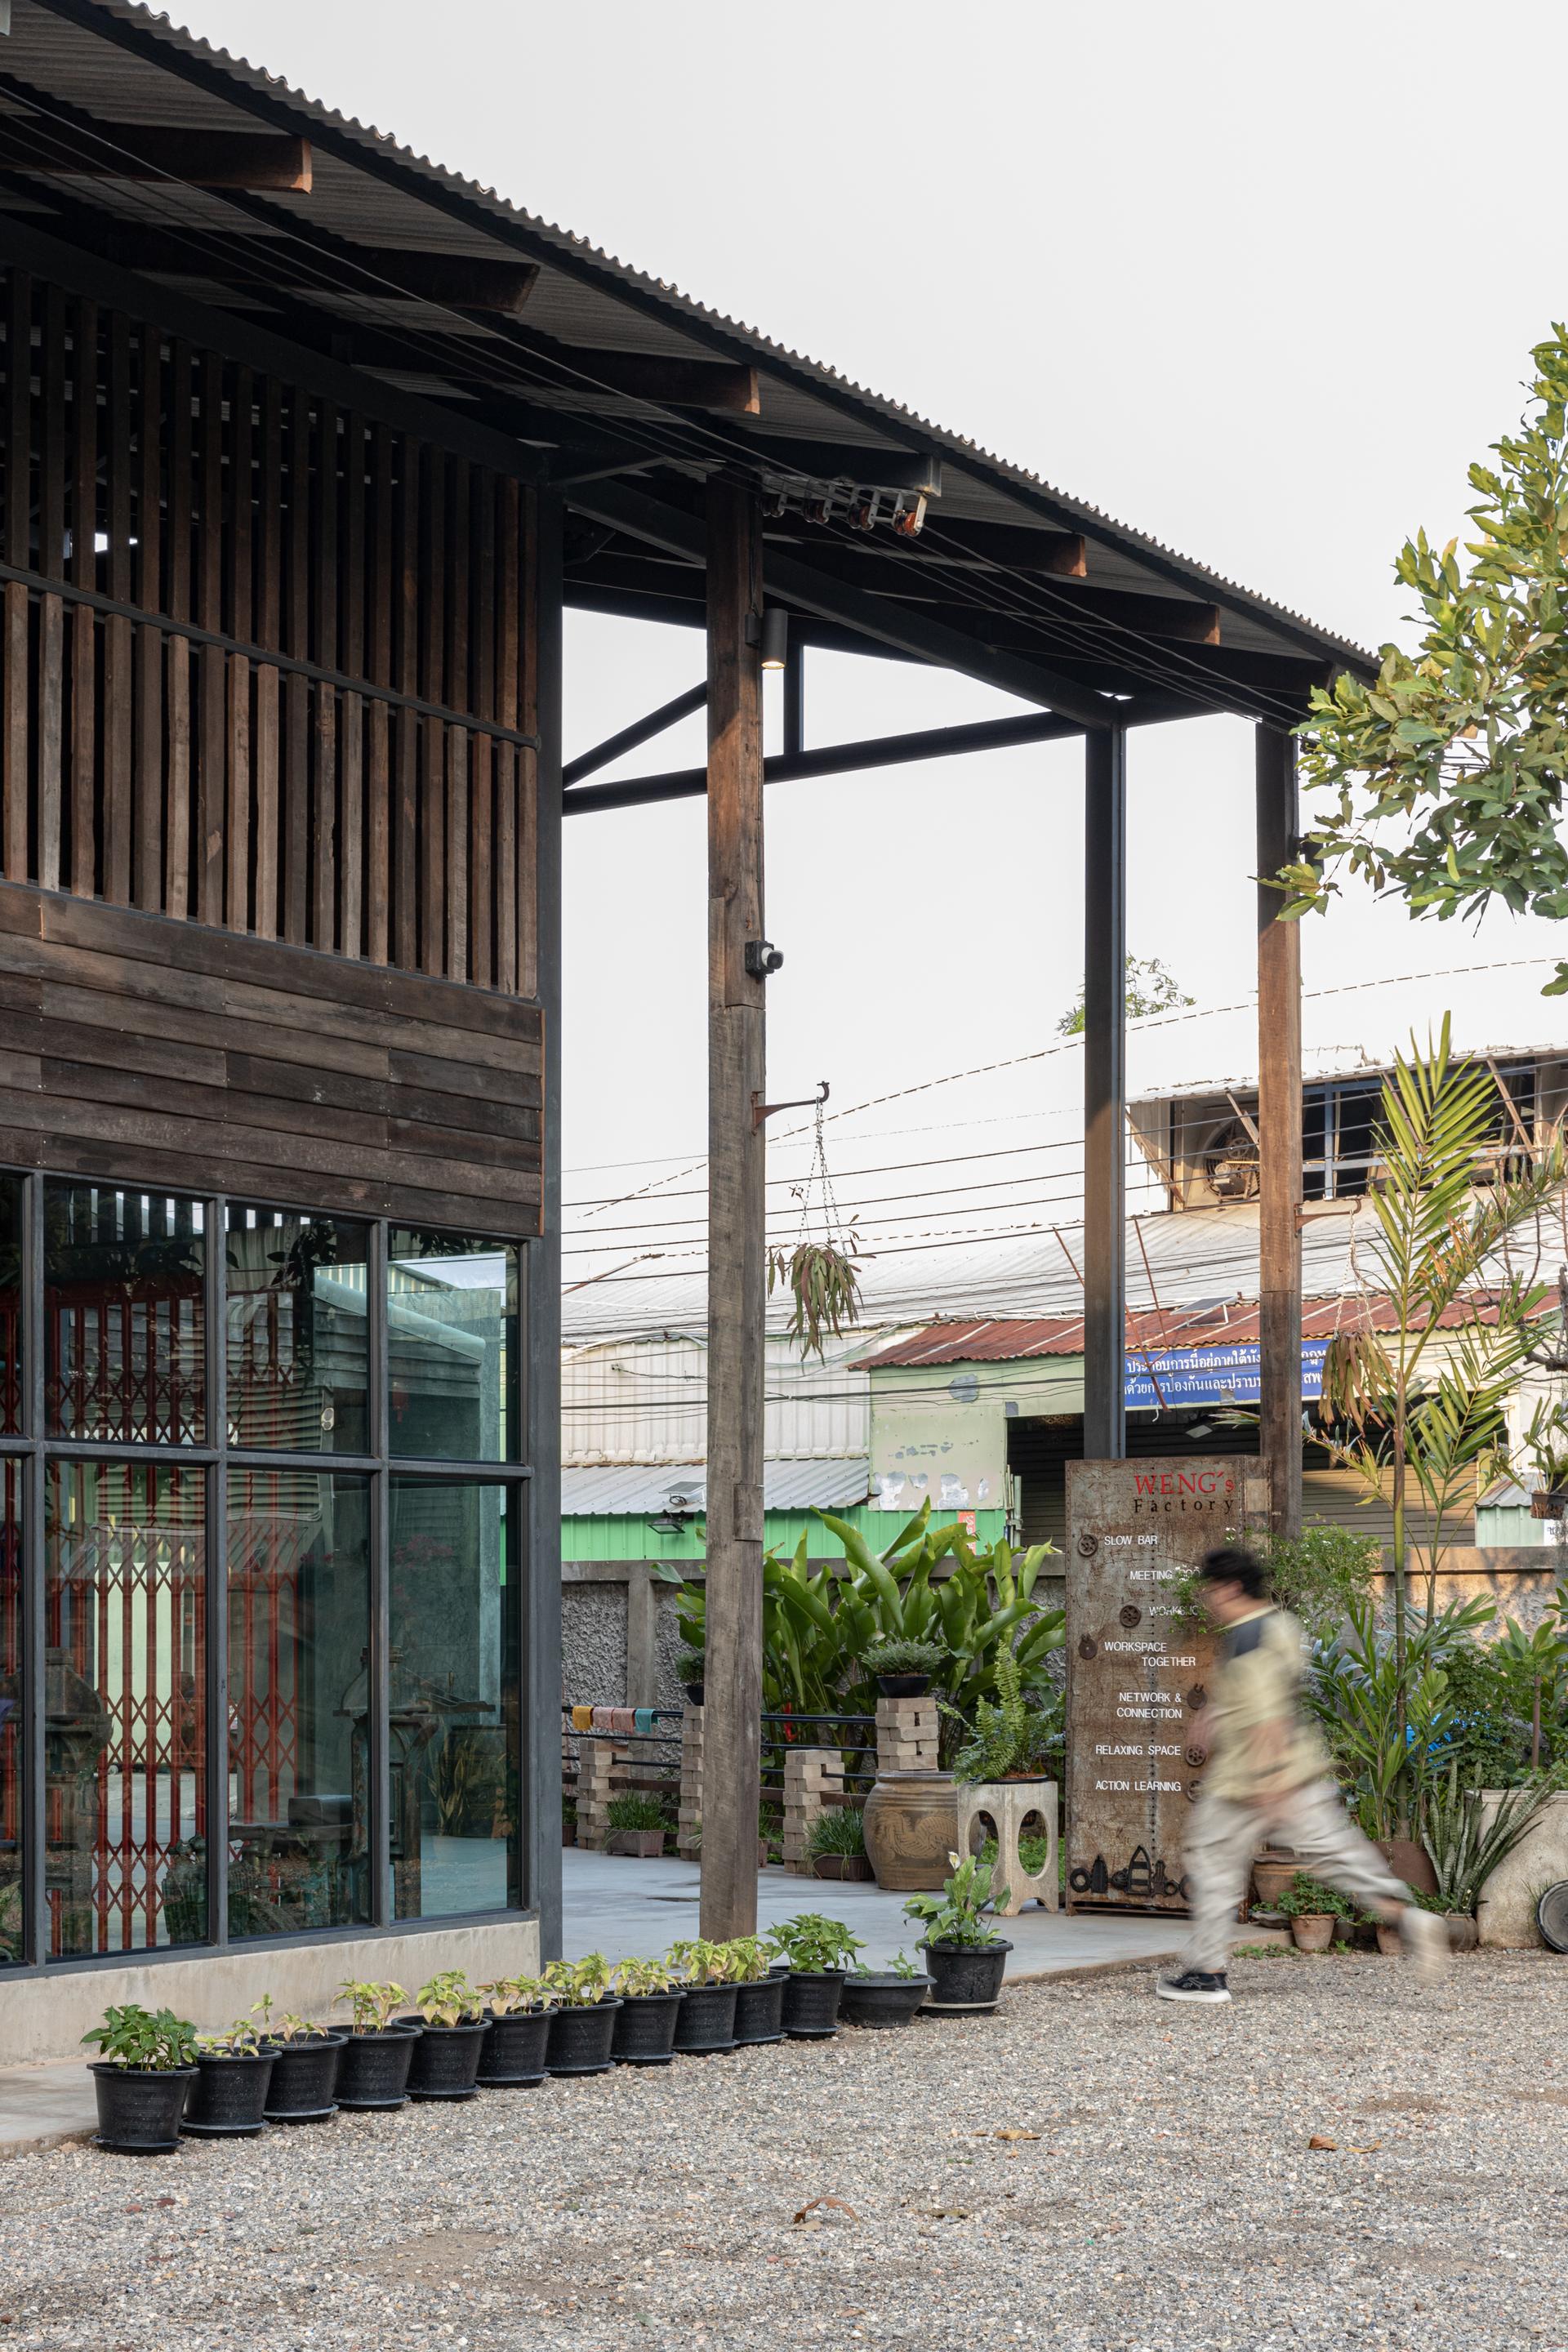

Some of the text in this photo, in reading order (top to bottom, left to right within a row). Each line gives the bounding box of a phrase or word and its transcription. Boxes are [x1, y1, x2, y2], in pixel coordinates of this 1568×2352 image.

[1134, 1498, 1234, 1515] Factory
[1104, 1535, 1158, 1546] SLOW BAR
[1129, 1570, 1173, 1581] MEETING
[1148, 1605, 1200, 1616] WORKSO
[1104, 1641, 1167, 1652] WORKSPACE
[1141, 1656, 1196, 1668] TOGETHER
[1119, 1692, 1182, 1703] NETWORK &
[1116, 1707, 1183, 1719] CONNECTION
[1095, 1744, 1181, 1756] RELAXING SPACE
[1095, 1780, 1182, 1792] ACTION LEARNING
